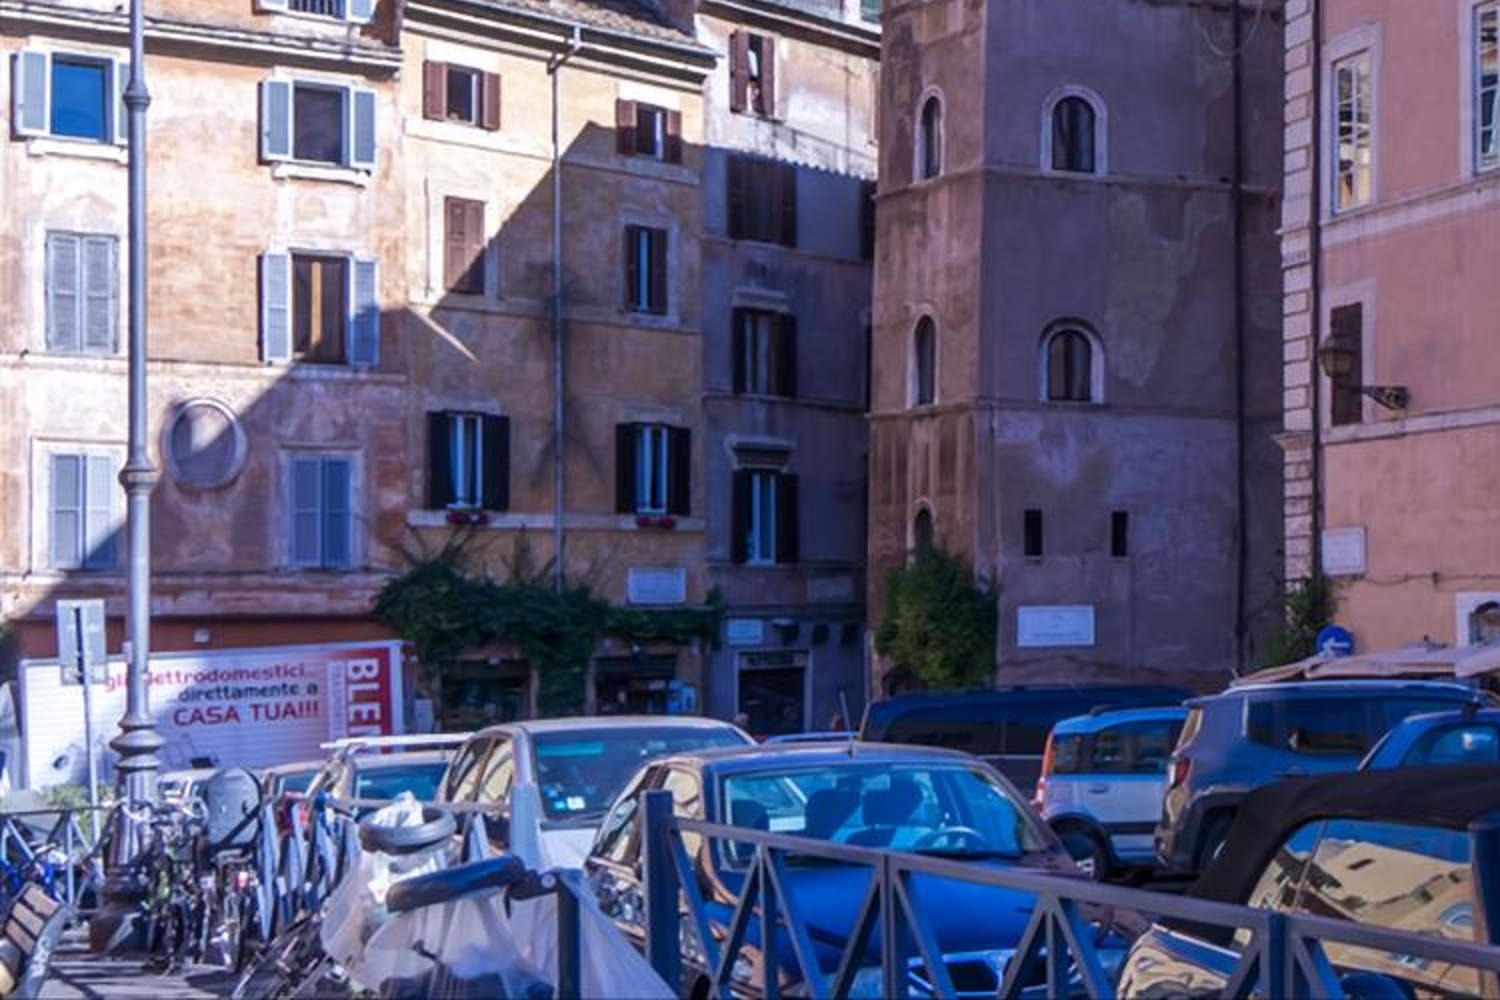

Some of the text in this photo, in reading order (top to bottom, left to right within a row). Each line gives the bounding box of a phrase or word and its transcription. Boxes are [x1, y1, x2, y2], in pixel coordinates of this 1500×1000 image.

[142, 664, 305, 686] lettrodomestici
[306, 682, 319, 696] a
[173, 701, 319, 727] CASA TUA!!!
